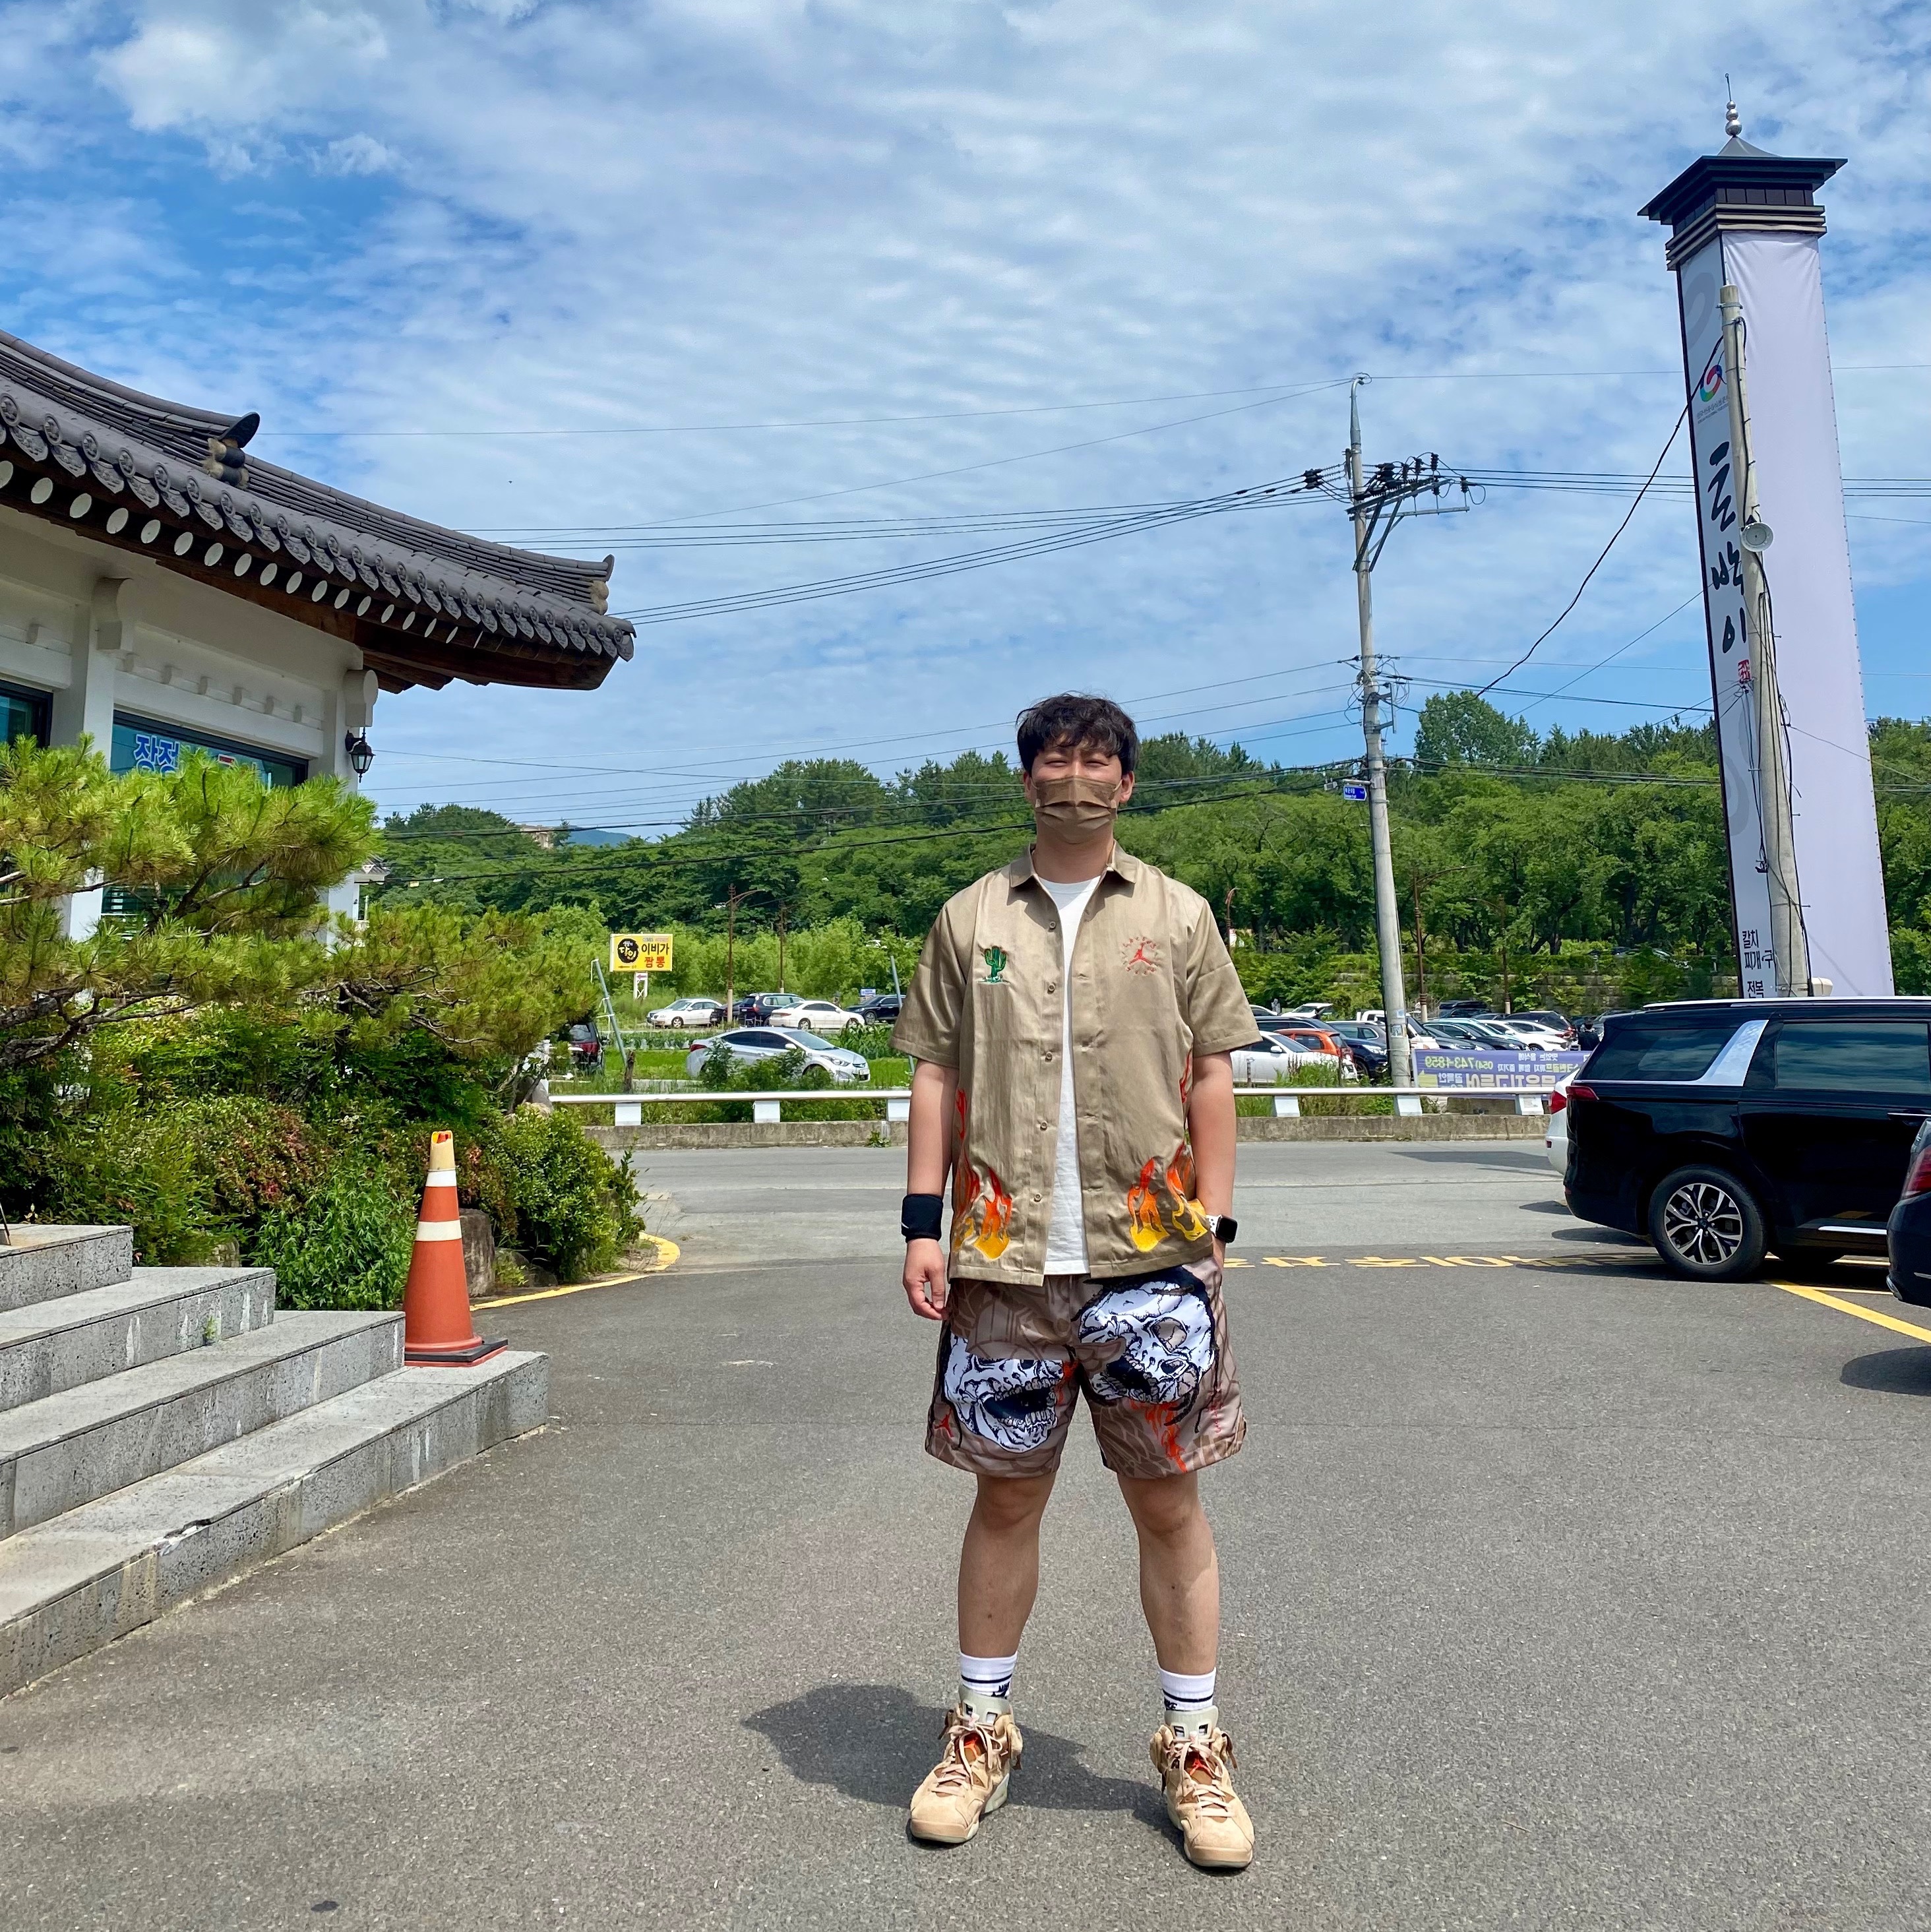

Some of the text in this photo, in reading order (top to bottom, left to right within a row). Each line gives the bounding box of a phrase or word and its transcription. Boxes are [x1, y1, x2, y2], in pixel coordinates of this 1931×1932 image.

[1742, 929, 1759, 949] 칼치
[641, 943, 669, 955] 이비가
[1747, 980, 1764, 999] 전복
